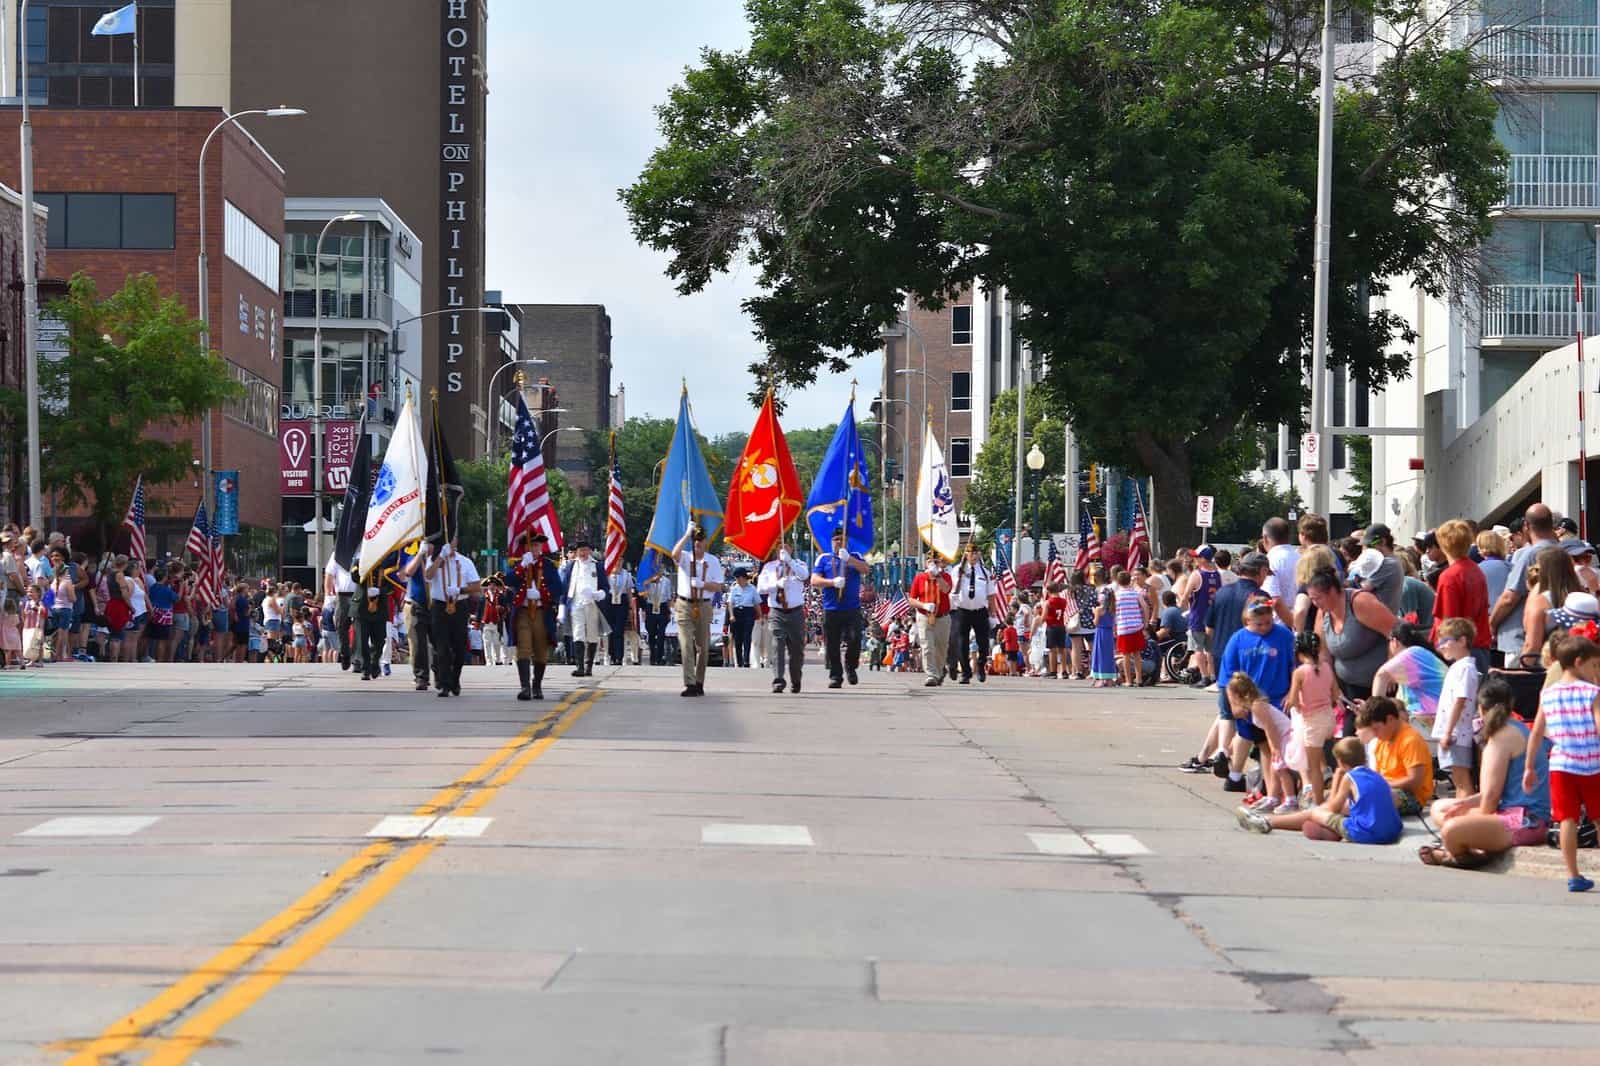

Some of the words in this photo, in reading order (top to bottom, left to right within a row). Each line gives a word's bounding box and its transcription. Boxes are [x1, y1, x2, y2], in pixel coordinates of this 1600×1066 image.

[447, 0, 468, 134] HOTEL
[443, 146, 470, 160] ON
[446, 173, 467, 393] PHILLIPS
[332, 426, 341, 464] SIOUX
[340, 427, 349, 464] FALLS
[282, 470, 309, 478] VISITOR
[287, 479, 304, 487] INFO
